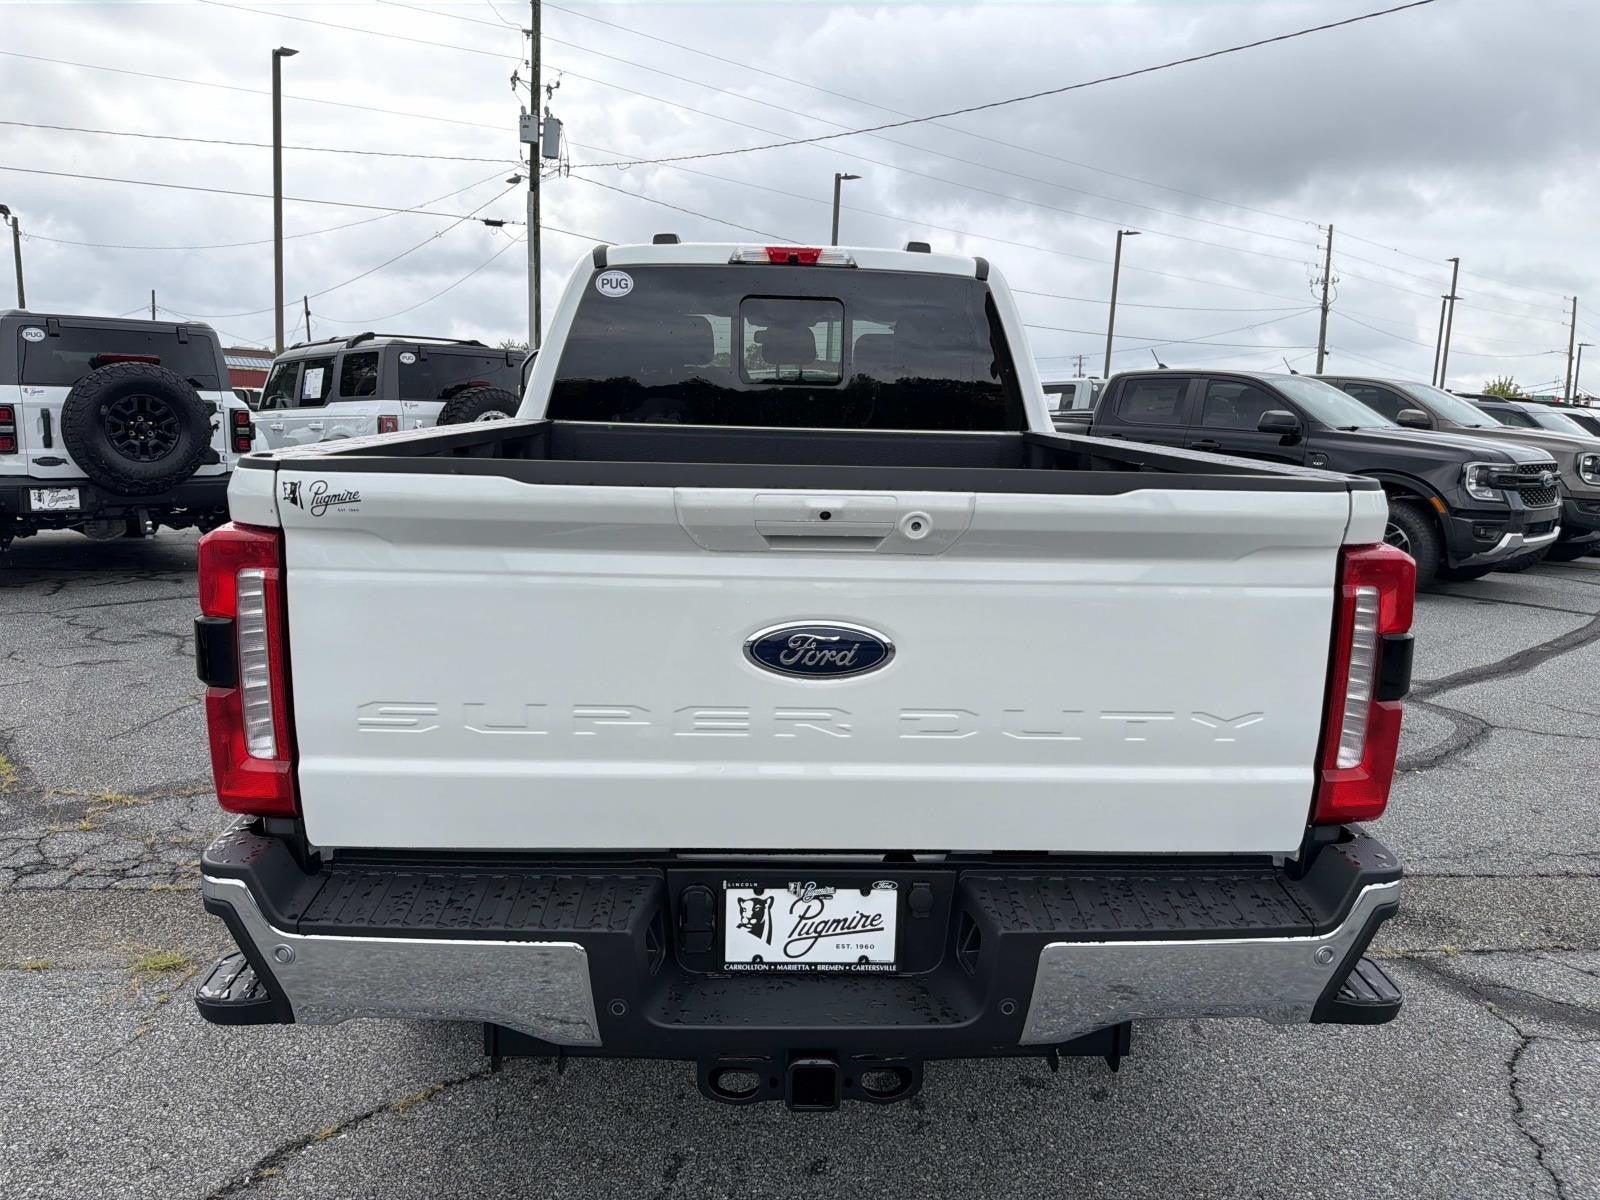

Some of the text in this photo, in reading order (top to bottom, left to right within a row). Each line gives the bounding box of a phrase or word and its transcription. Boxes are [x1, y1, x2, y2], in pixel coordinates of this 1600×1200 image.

[601, 278, 629, 289] PUG
[309, 480, 362, 517] Pugmire
[779, 633, 861, 666] Ford
[357, 701, 1264, 742] SUPER DUTY
[877, 881, 893, 889] Ford
[783, 897, 885, 959] Pugmire
[724, 963, 769, 971] CARROLLTON
